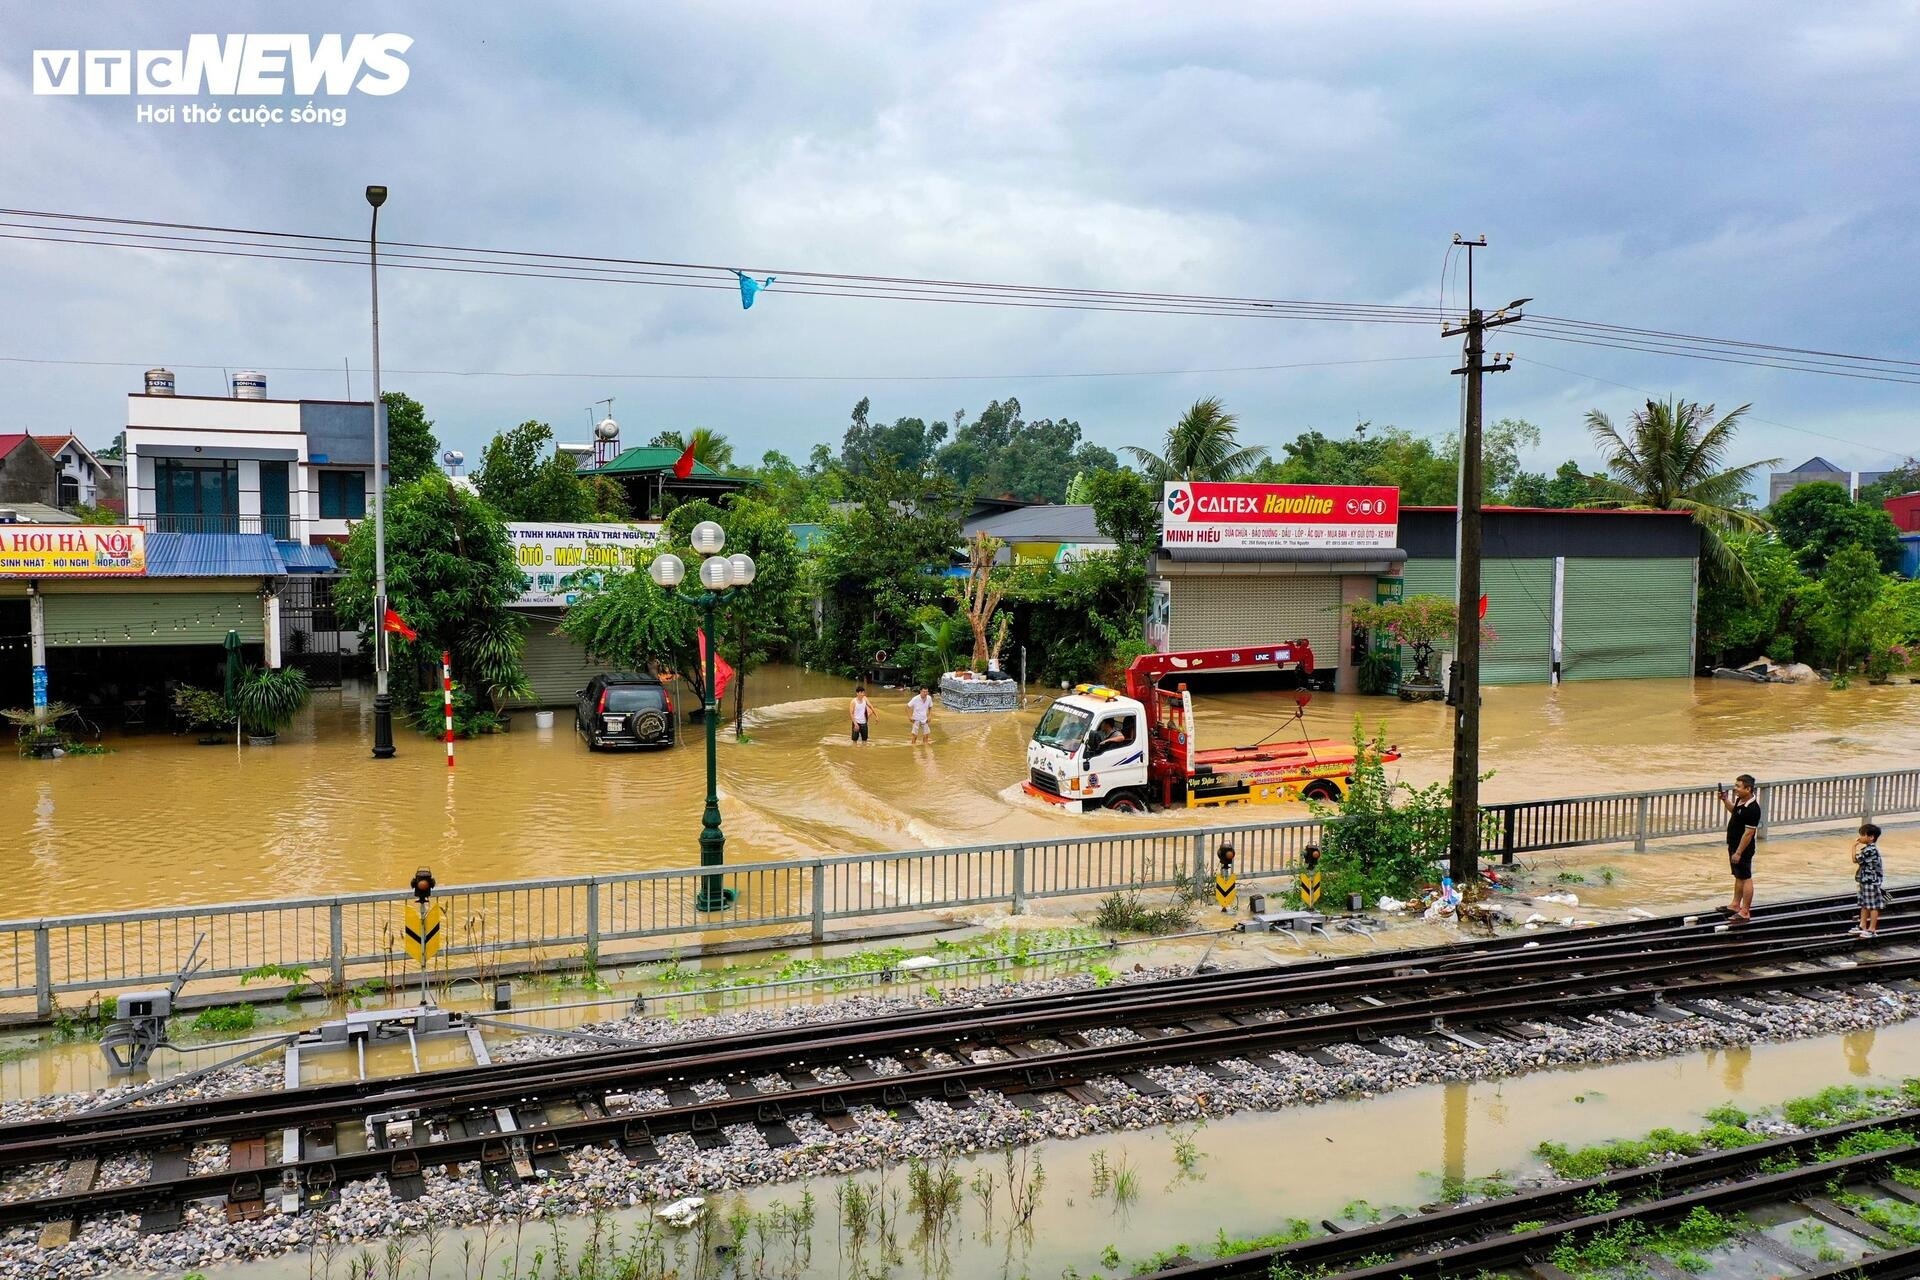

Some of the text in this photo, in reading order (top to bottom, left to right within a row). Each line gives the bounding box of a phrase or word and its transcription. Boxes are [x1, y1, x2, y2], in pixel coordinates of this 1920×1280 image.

[1197, 494, 1334, 514] CALTEX Havoline
[12, 533, 53, 552] HƠI
[58, 530, 89, 552] HÀ
[95, 530, 133, 552] NỘI
[520, 530, 544, 538] TNHH
[1166, 530, 1194, 542] MINH
[1197, 526, 1221, 542] HIẾU
[0, 558, 21, 567] SINH
[23, 558, 45, 569] NHẬT
[53, 558, 68, 568] HỘI
[97, 558, 115, 569] HỌP
[519, 543, 543, 566] ÔTÔ
[554, 544, 582, 566] MÁY
